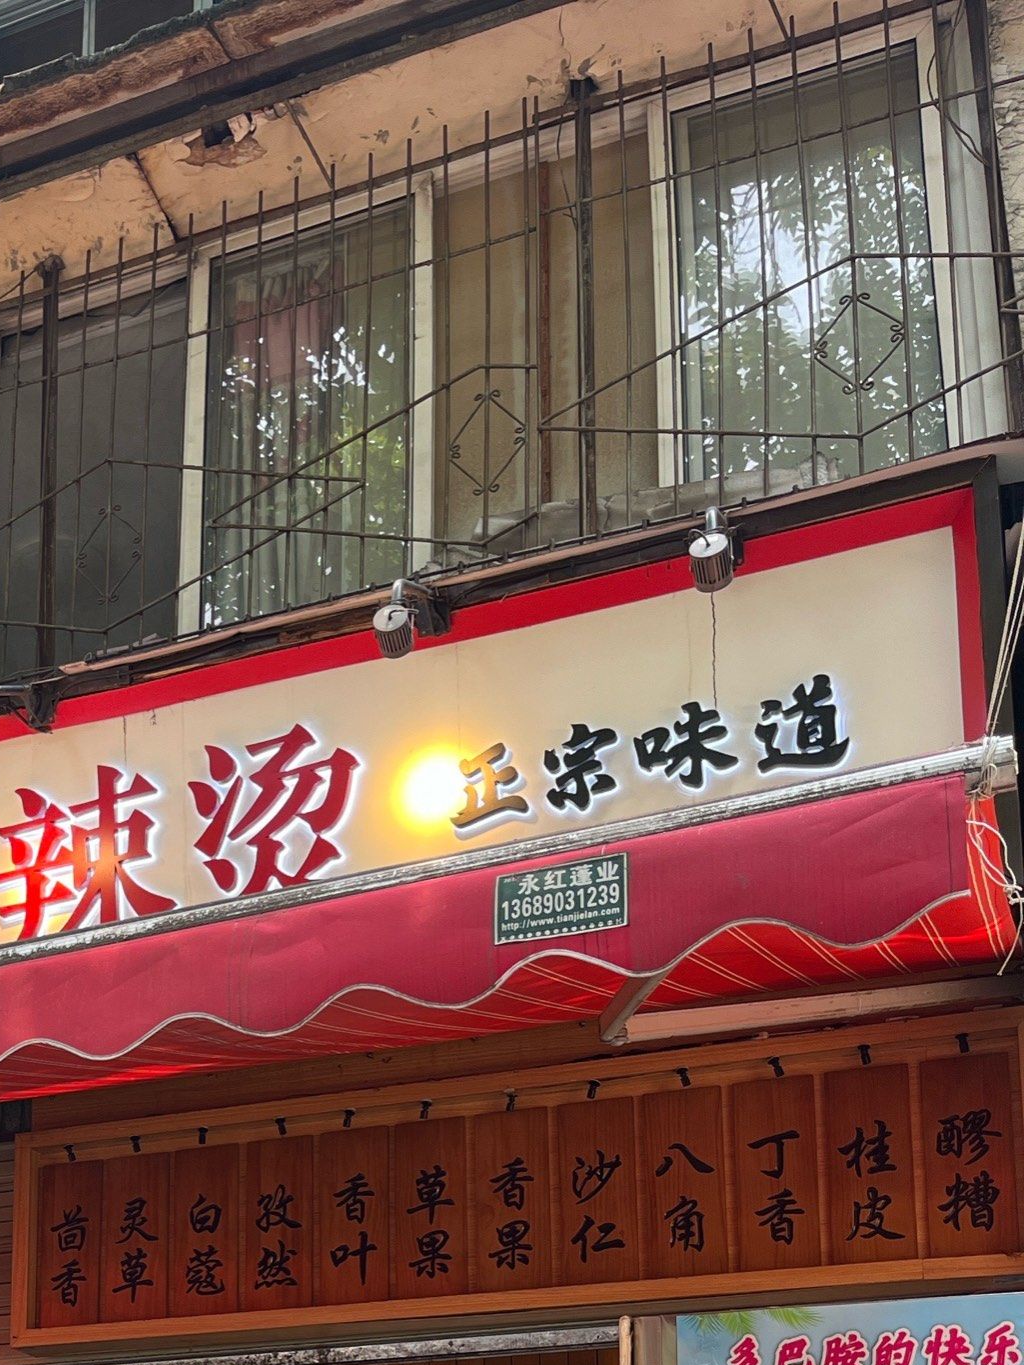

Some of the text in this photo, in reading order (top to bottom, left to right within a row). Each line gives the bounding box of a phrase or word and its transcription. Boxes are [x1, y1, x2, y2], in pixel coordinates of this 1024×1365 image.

[450, 674, 850, 829] 正宗味道
[501, 883, 620, 920] 13689031239
[406, 1165, 455, 1279] 草果
[488, 1157, 535, 1270] 香果
[571, 1149, 626, 1264] 沙仁
[655, 1142, 715, 1253] 八角
[747, 1129, 806, 1245] 丁香
[837, 1120, 906, 1242] 桂皮
[935, 1108, 1003, 1232] 醪糟
[50, 1206, 90, 1306] 茴香
[112, 1197, 159, 1303] 灵草
[186, 1194, 226, 1296] 白蔻
[255, 1184, 302, 1290] 孜然
[330, 1172, 377, 1285] 香叶
